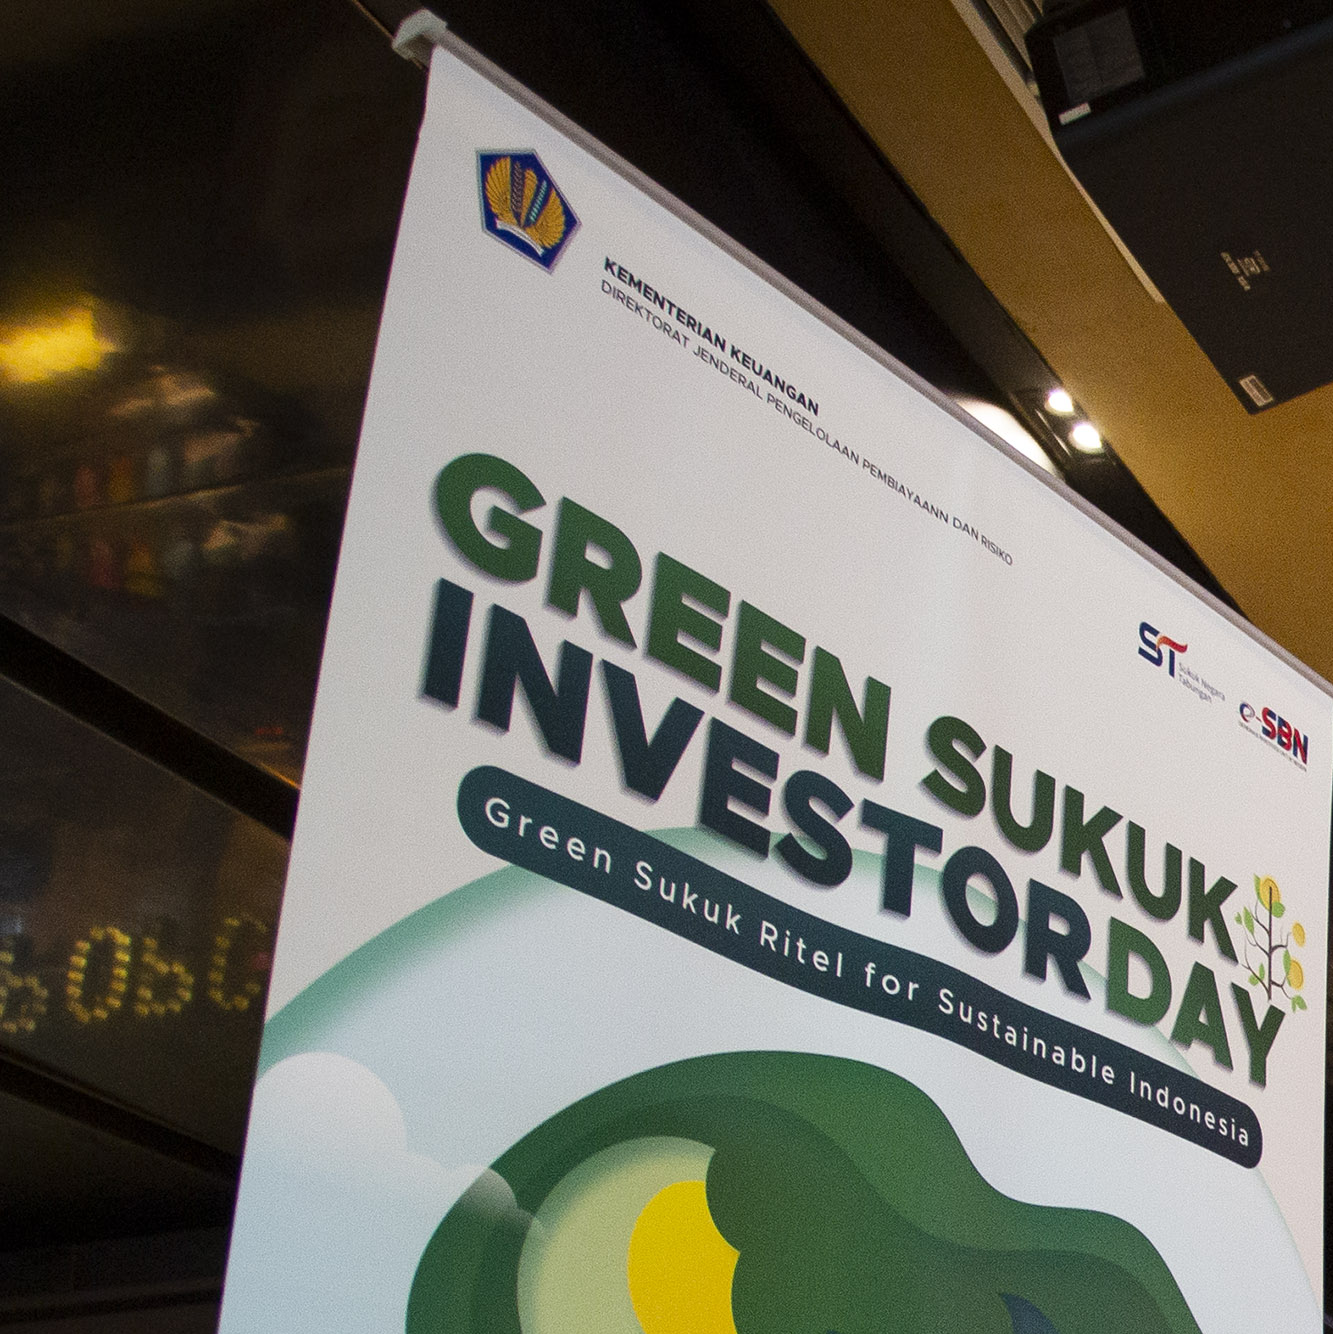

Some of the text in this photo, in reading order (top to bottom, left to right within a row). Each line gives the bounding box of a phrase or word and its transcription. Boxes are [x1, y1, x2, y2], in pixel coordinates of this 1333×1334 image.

[600, 279, 690, 348] DIREKTORAT
[693, 345, 764, 401] JENDERAL
[767, 392, 859, 465] PENGELOLAAN
[952, 517, 979, 541] DAN
[981, 534, 1013, 566] RISIKO
[604, 256, 819, 416] KEMENTERIAN KEUANGAN
[432, 452, 1239, 967] GREEN SUKUK
[1138, 621, 1188, 678] ST
[484, 796, 1250, 1147] Green Sukuk Ritel for Sustainable Indonesia
